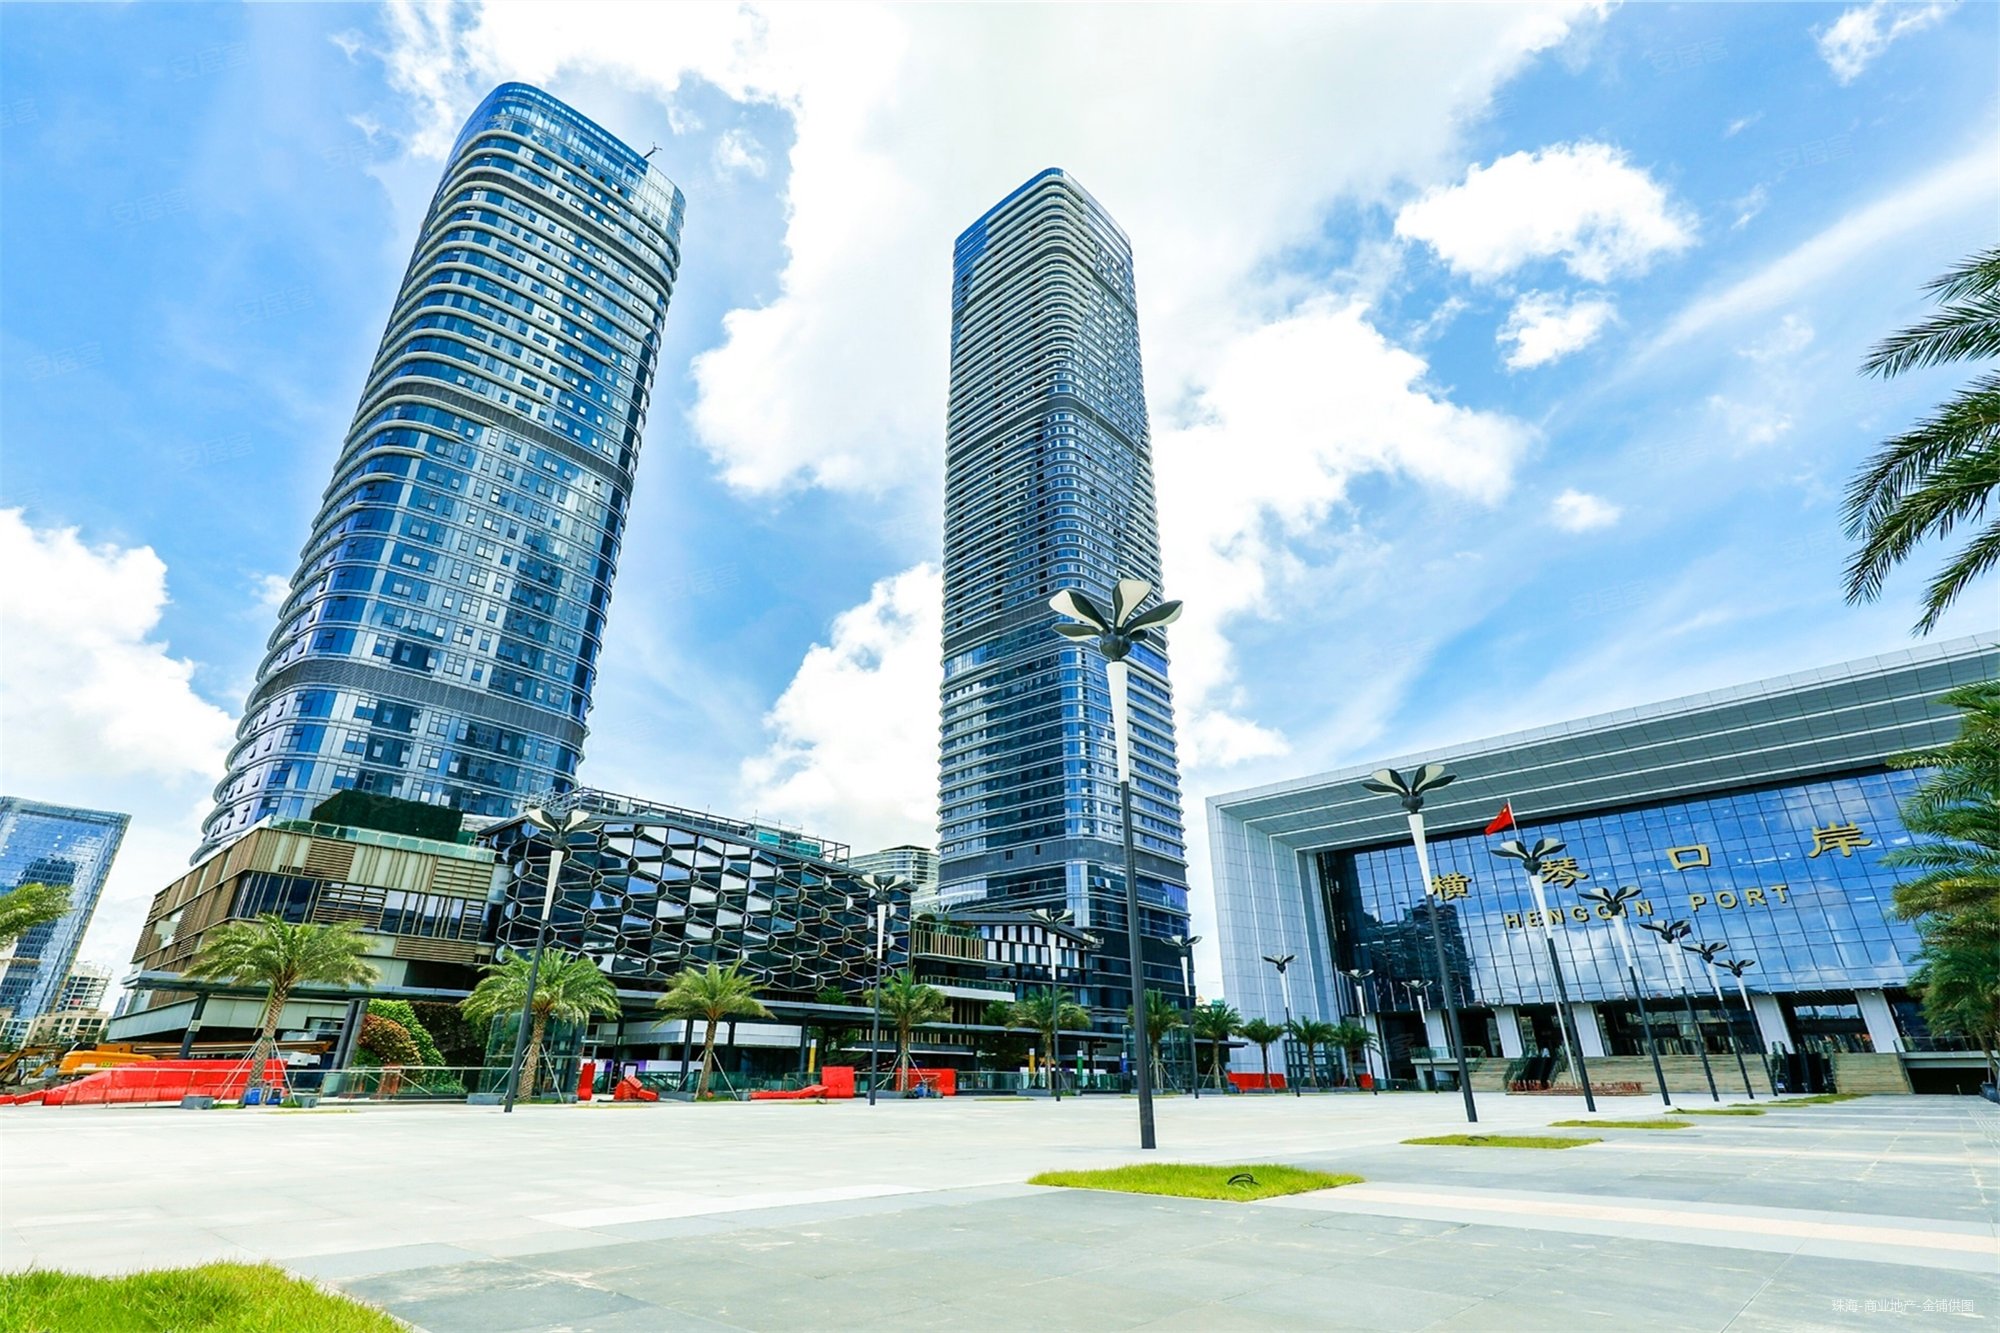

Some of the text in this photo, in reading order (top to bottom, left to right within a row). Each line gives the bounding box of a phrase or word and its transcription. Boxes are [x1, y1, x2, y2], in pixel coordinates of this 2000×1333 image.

[1432, 821, 1873, 901] 横琴口岸
[1689, 884, 1789, 912] PORT
